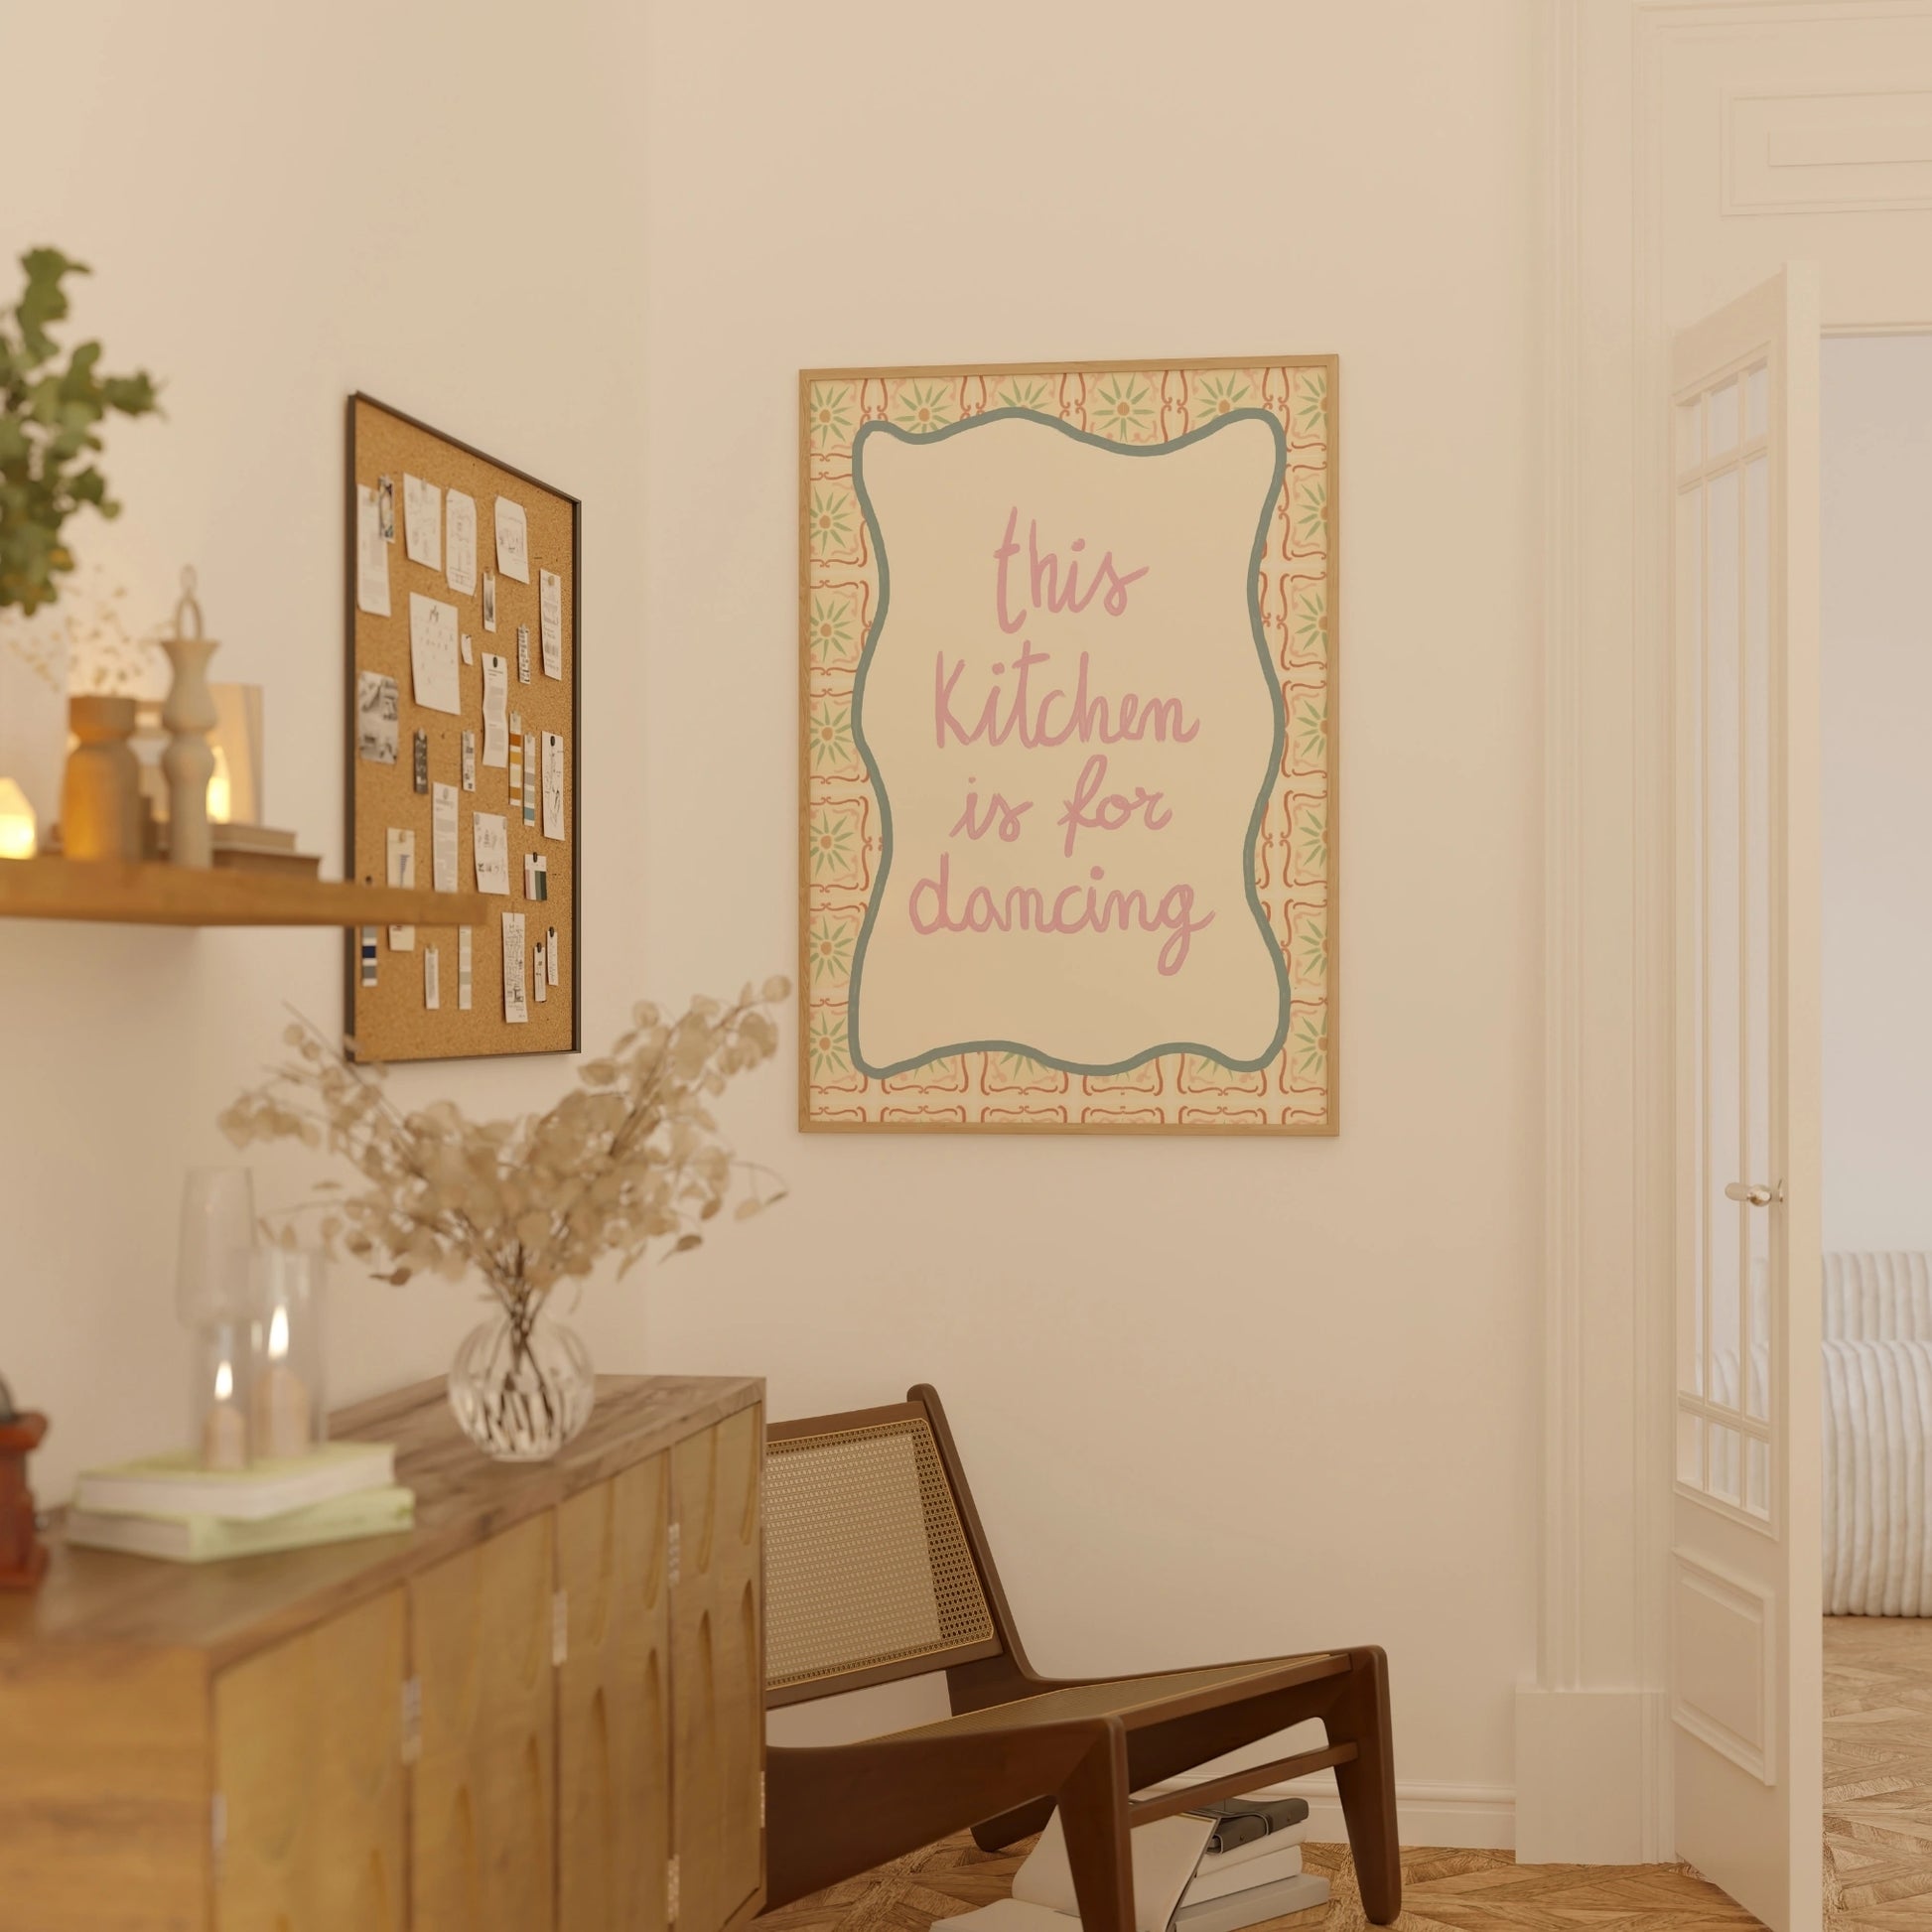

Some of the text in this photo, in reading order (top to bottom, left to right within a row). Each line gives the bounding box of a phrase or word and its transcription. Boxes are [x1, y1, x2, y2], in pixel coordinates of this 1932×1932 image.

[994, 506, 1150, 635] this
[949, 753, 1173, 859] is for
[907, 851, 1216, 977] dancing
